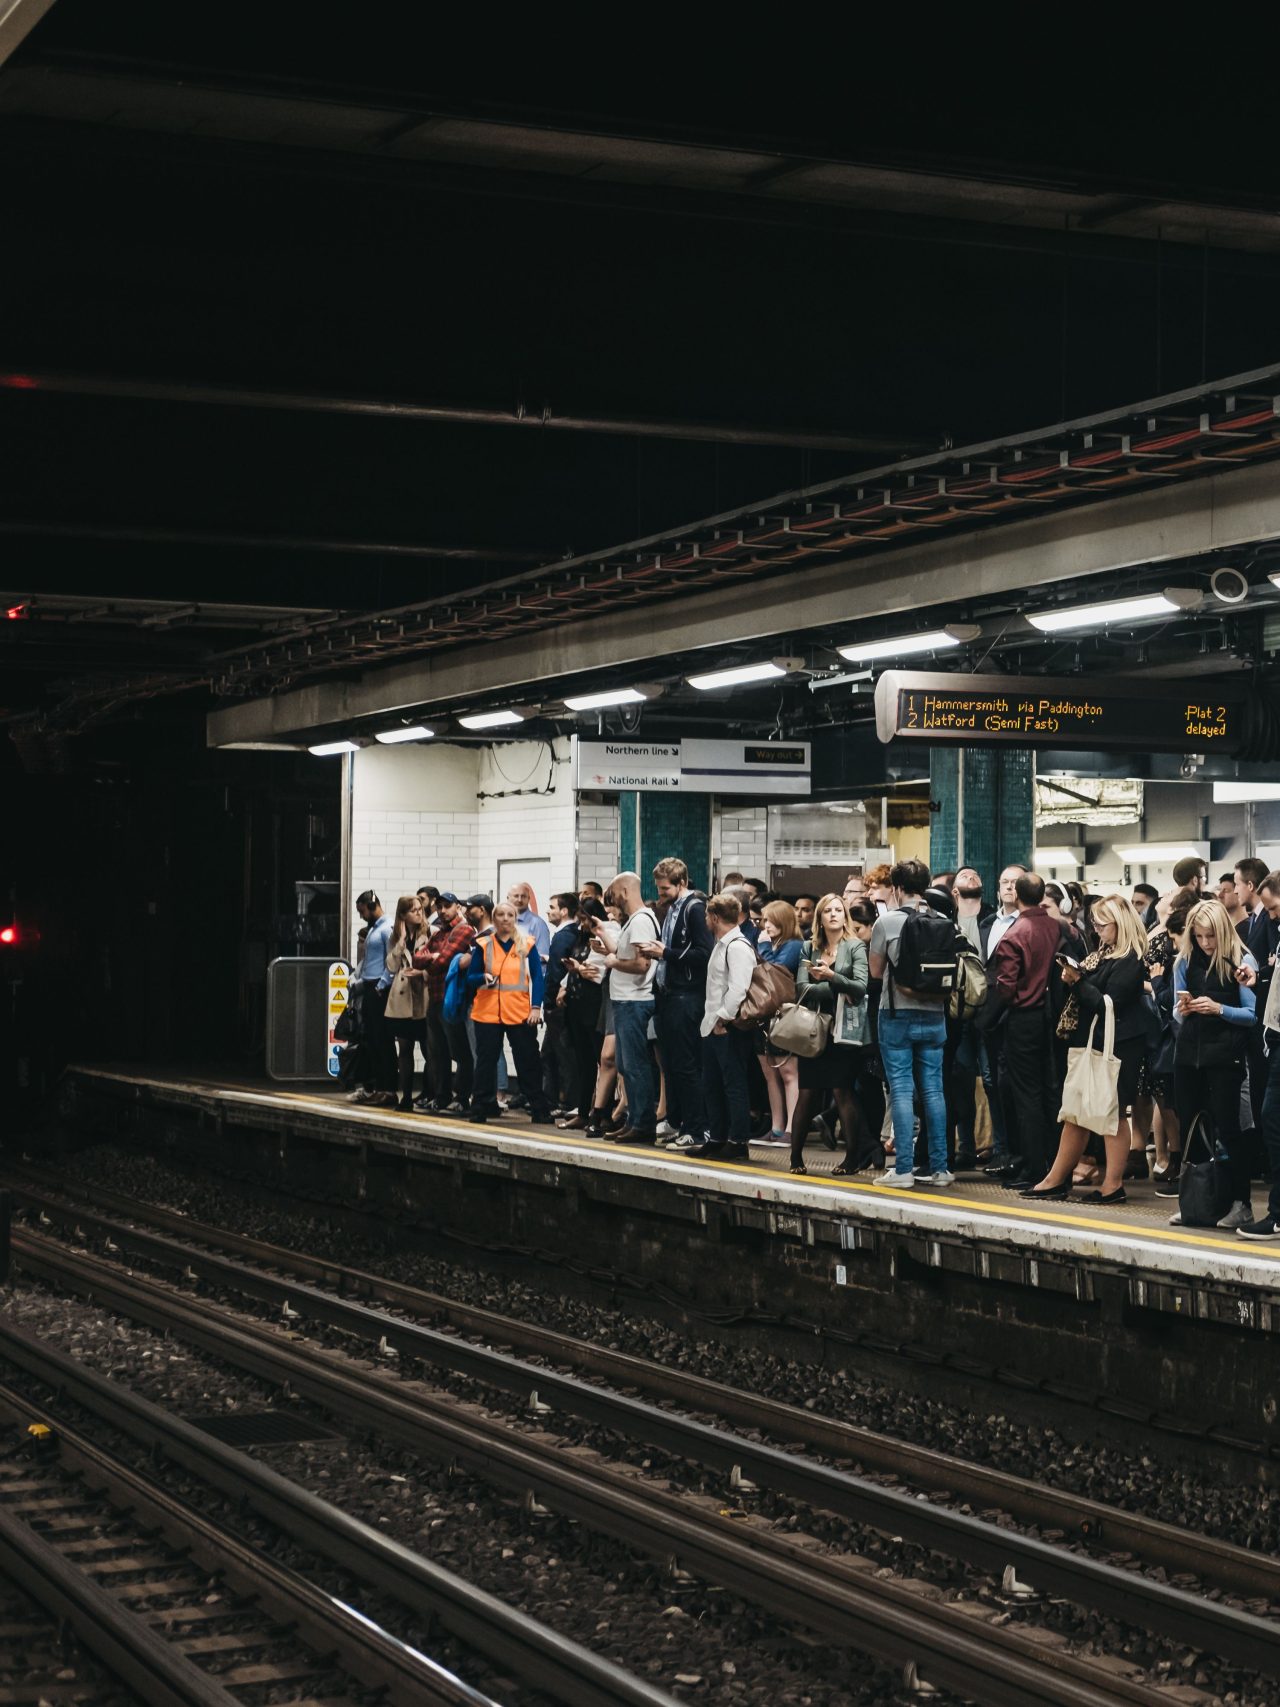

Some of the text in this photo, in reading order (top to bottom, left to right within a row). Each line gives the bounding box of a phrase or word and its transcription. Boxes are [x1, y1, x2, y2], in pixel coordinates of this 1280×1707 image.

[908, 695, 1103, 719] 1 Hammersmith via Paddington
[1186, 705, 1226, 722] Plat 2
[907, 711, 1059, 733] 2 Watford (Semi Fast)
[1186, 723, 1226, 738] delayed
[605, 746, 669, 756] Northern line
[756, 751, 793, 761] Way out
[608, 776, 669, 786] National Rail
